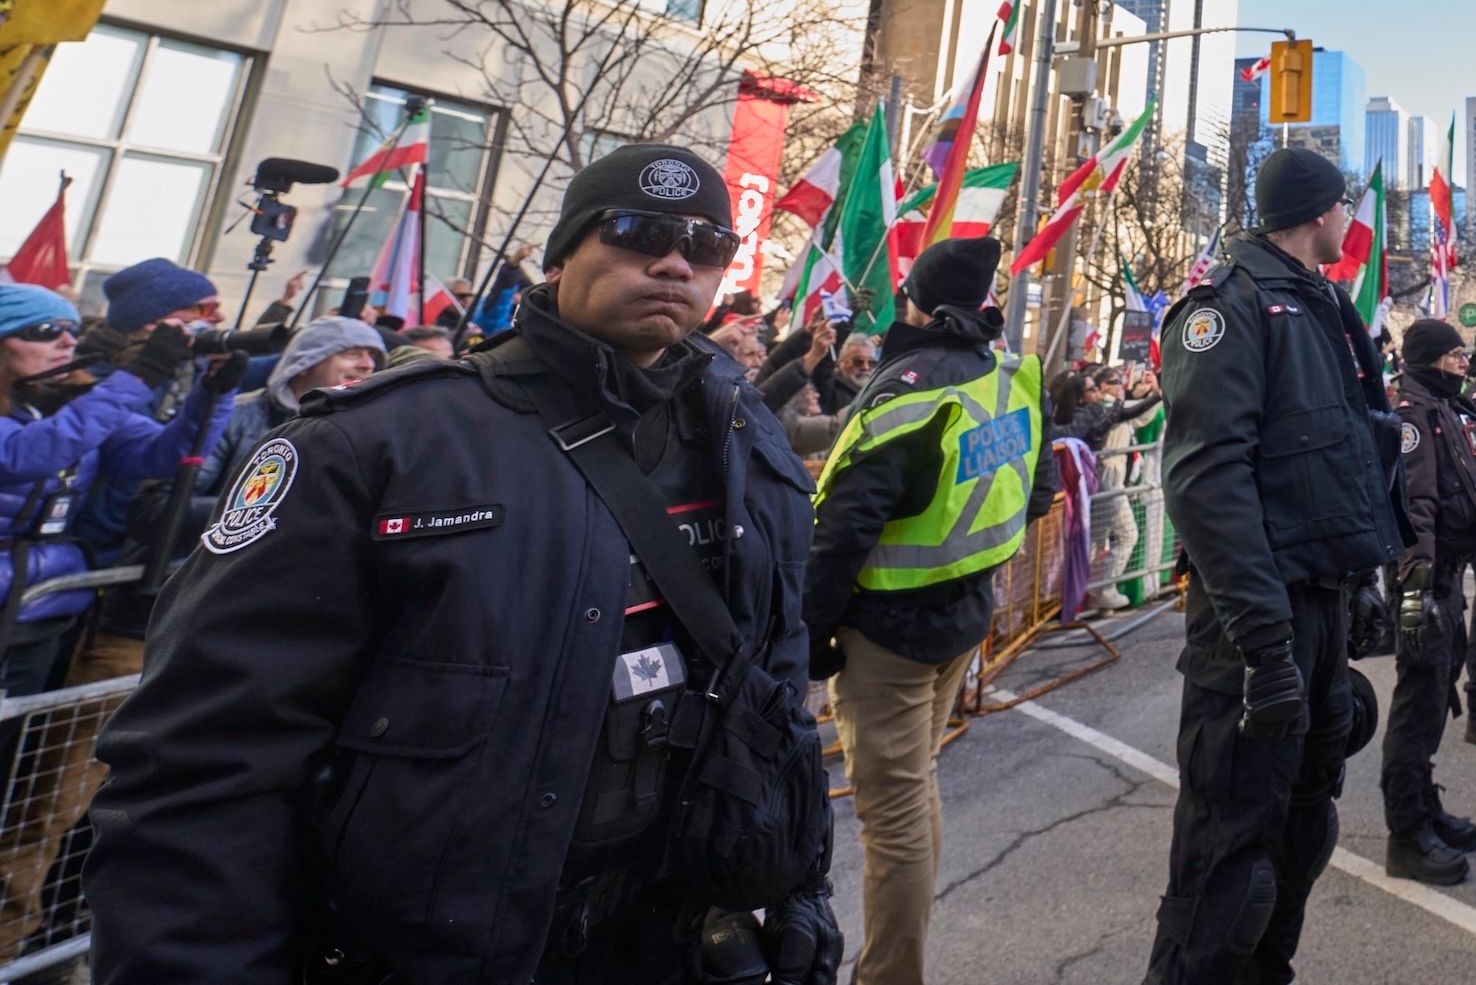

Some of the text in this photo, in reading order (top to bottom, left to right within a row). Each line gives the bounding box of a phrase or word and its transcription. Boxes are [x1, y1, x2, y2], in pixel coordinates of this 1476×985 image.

[651, 186, 688, 198] POLICE
[967, 415, 1021, 454] POLICE
[253, 444, 294, 466] TORONTO
[963, 431, 1027, 476] LIAISON
[225, 506, 265, 528] POLICE
[413, 510, 493, 529] J. Jamandra
